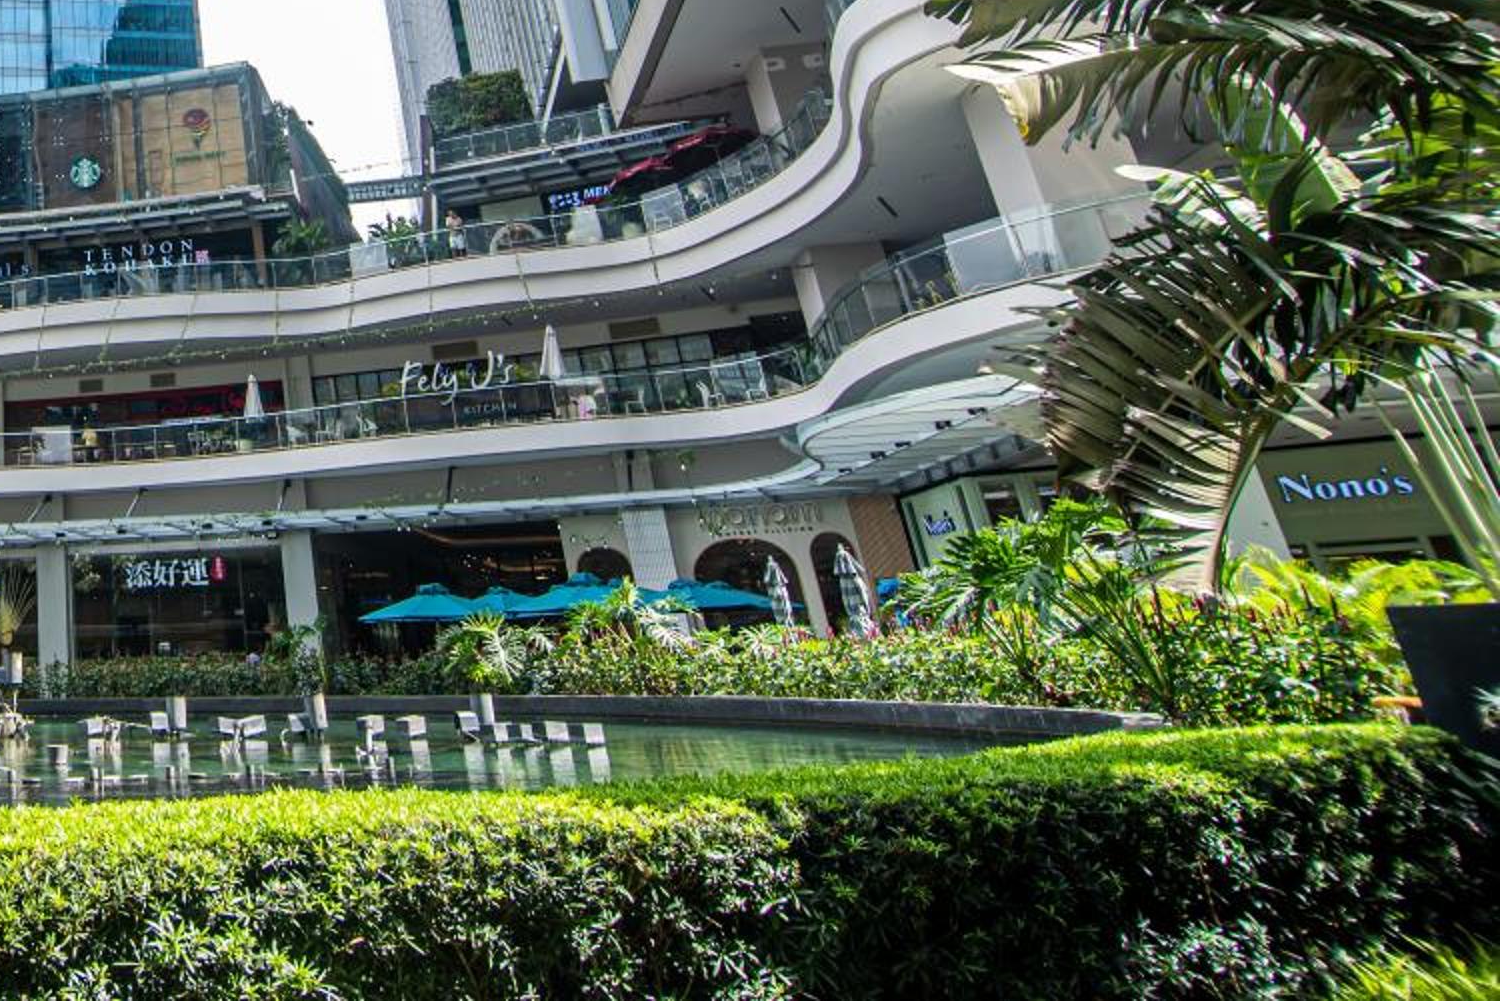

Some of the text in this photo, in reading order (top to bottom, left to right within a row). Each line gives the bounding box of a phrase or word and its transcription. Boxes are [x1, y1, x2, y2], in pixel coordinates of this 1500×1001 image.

[83, 238, 193, 262] TENDON
[400, 350, 516, 405] Fely J's
[1278, 465, 1413, 503] Nono's
[125, 558, 210, 589] 添好運
